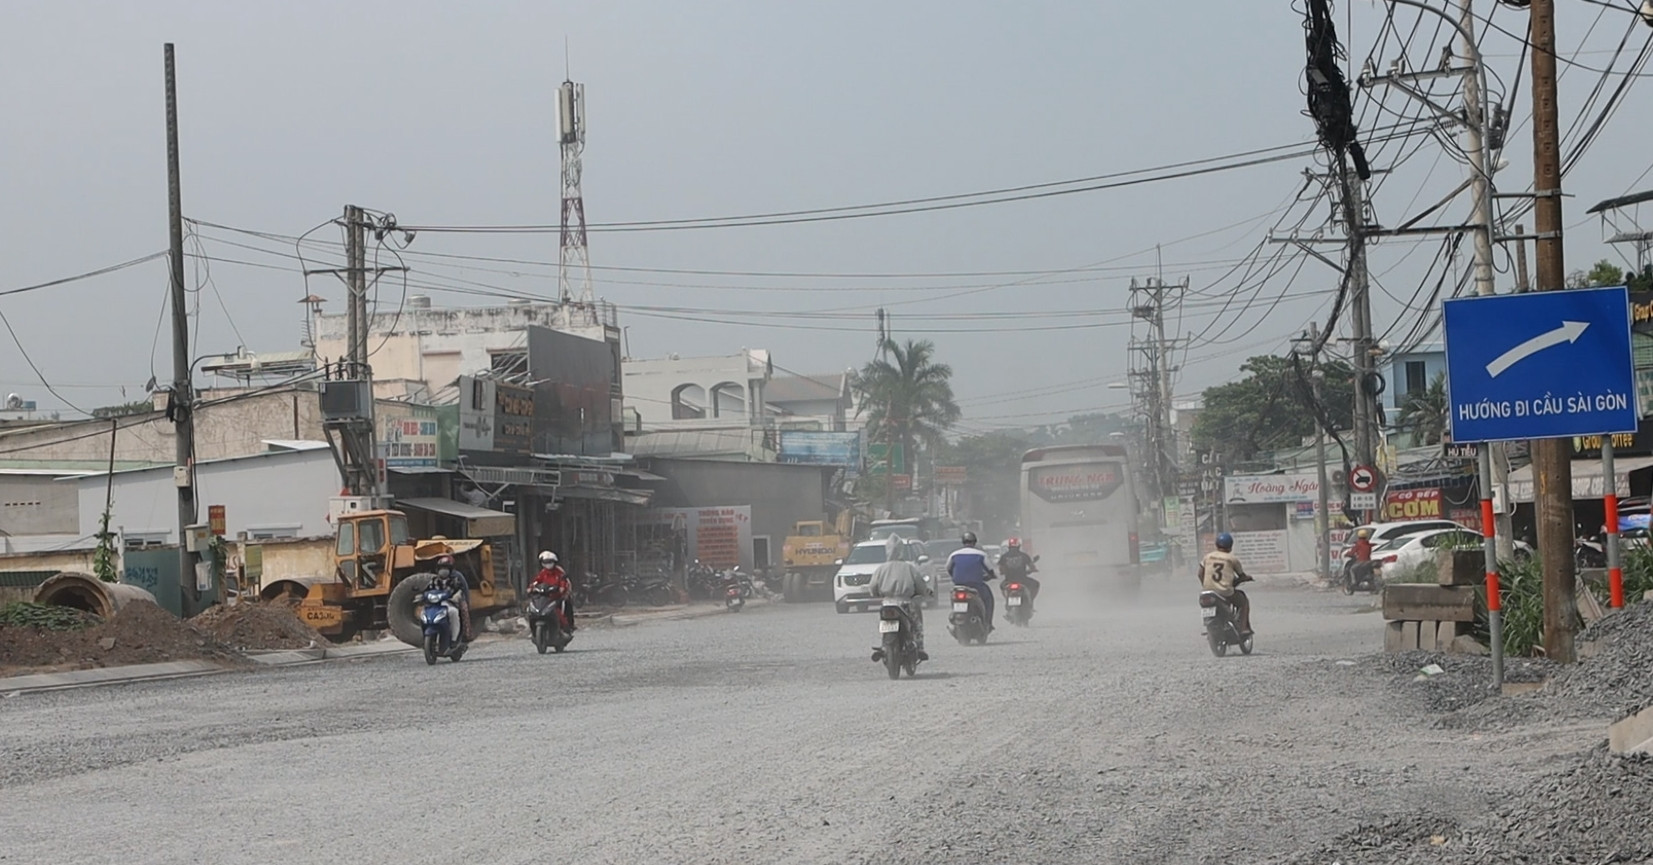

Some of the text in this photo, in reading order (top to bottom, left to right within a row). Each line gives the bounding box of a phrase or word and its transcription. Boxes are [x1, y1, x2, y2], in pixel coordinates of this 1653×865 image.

[1459, 389, 1627, 421] HƯỚNG ĐI CẦU SÀI GÒN
[1388, 498, 1440, 518] CƠM
[795, 547, 836, 556] HYUNDAI
[1212, 562, 1225, 583] 3
